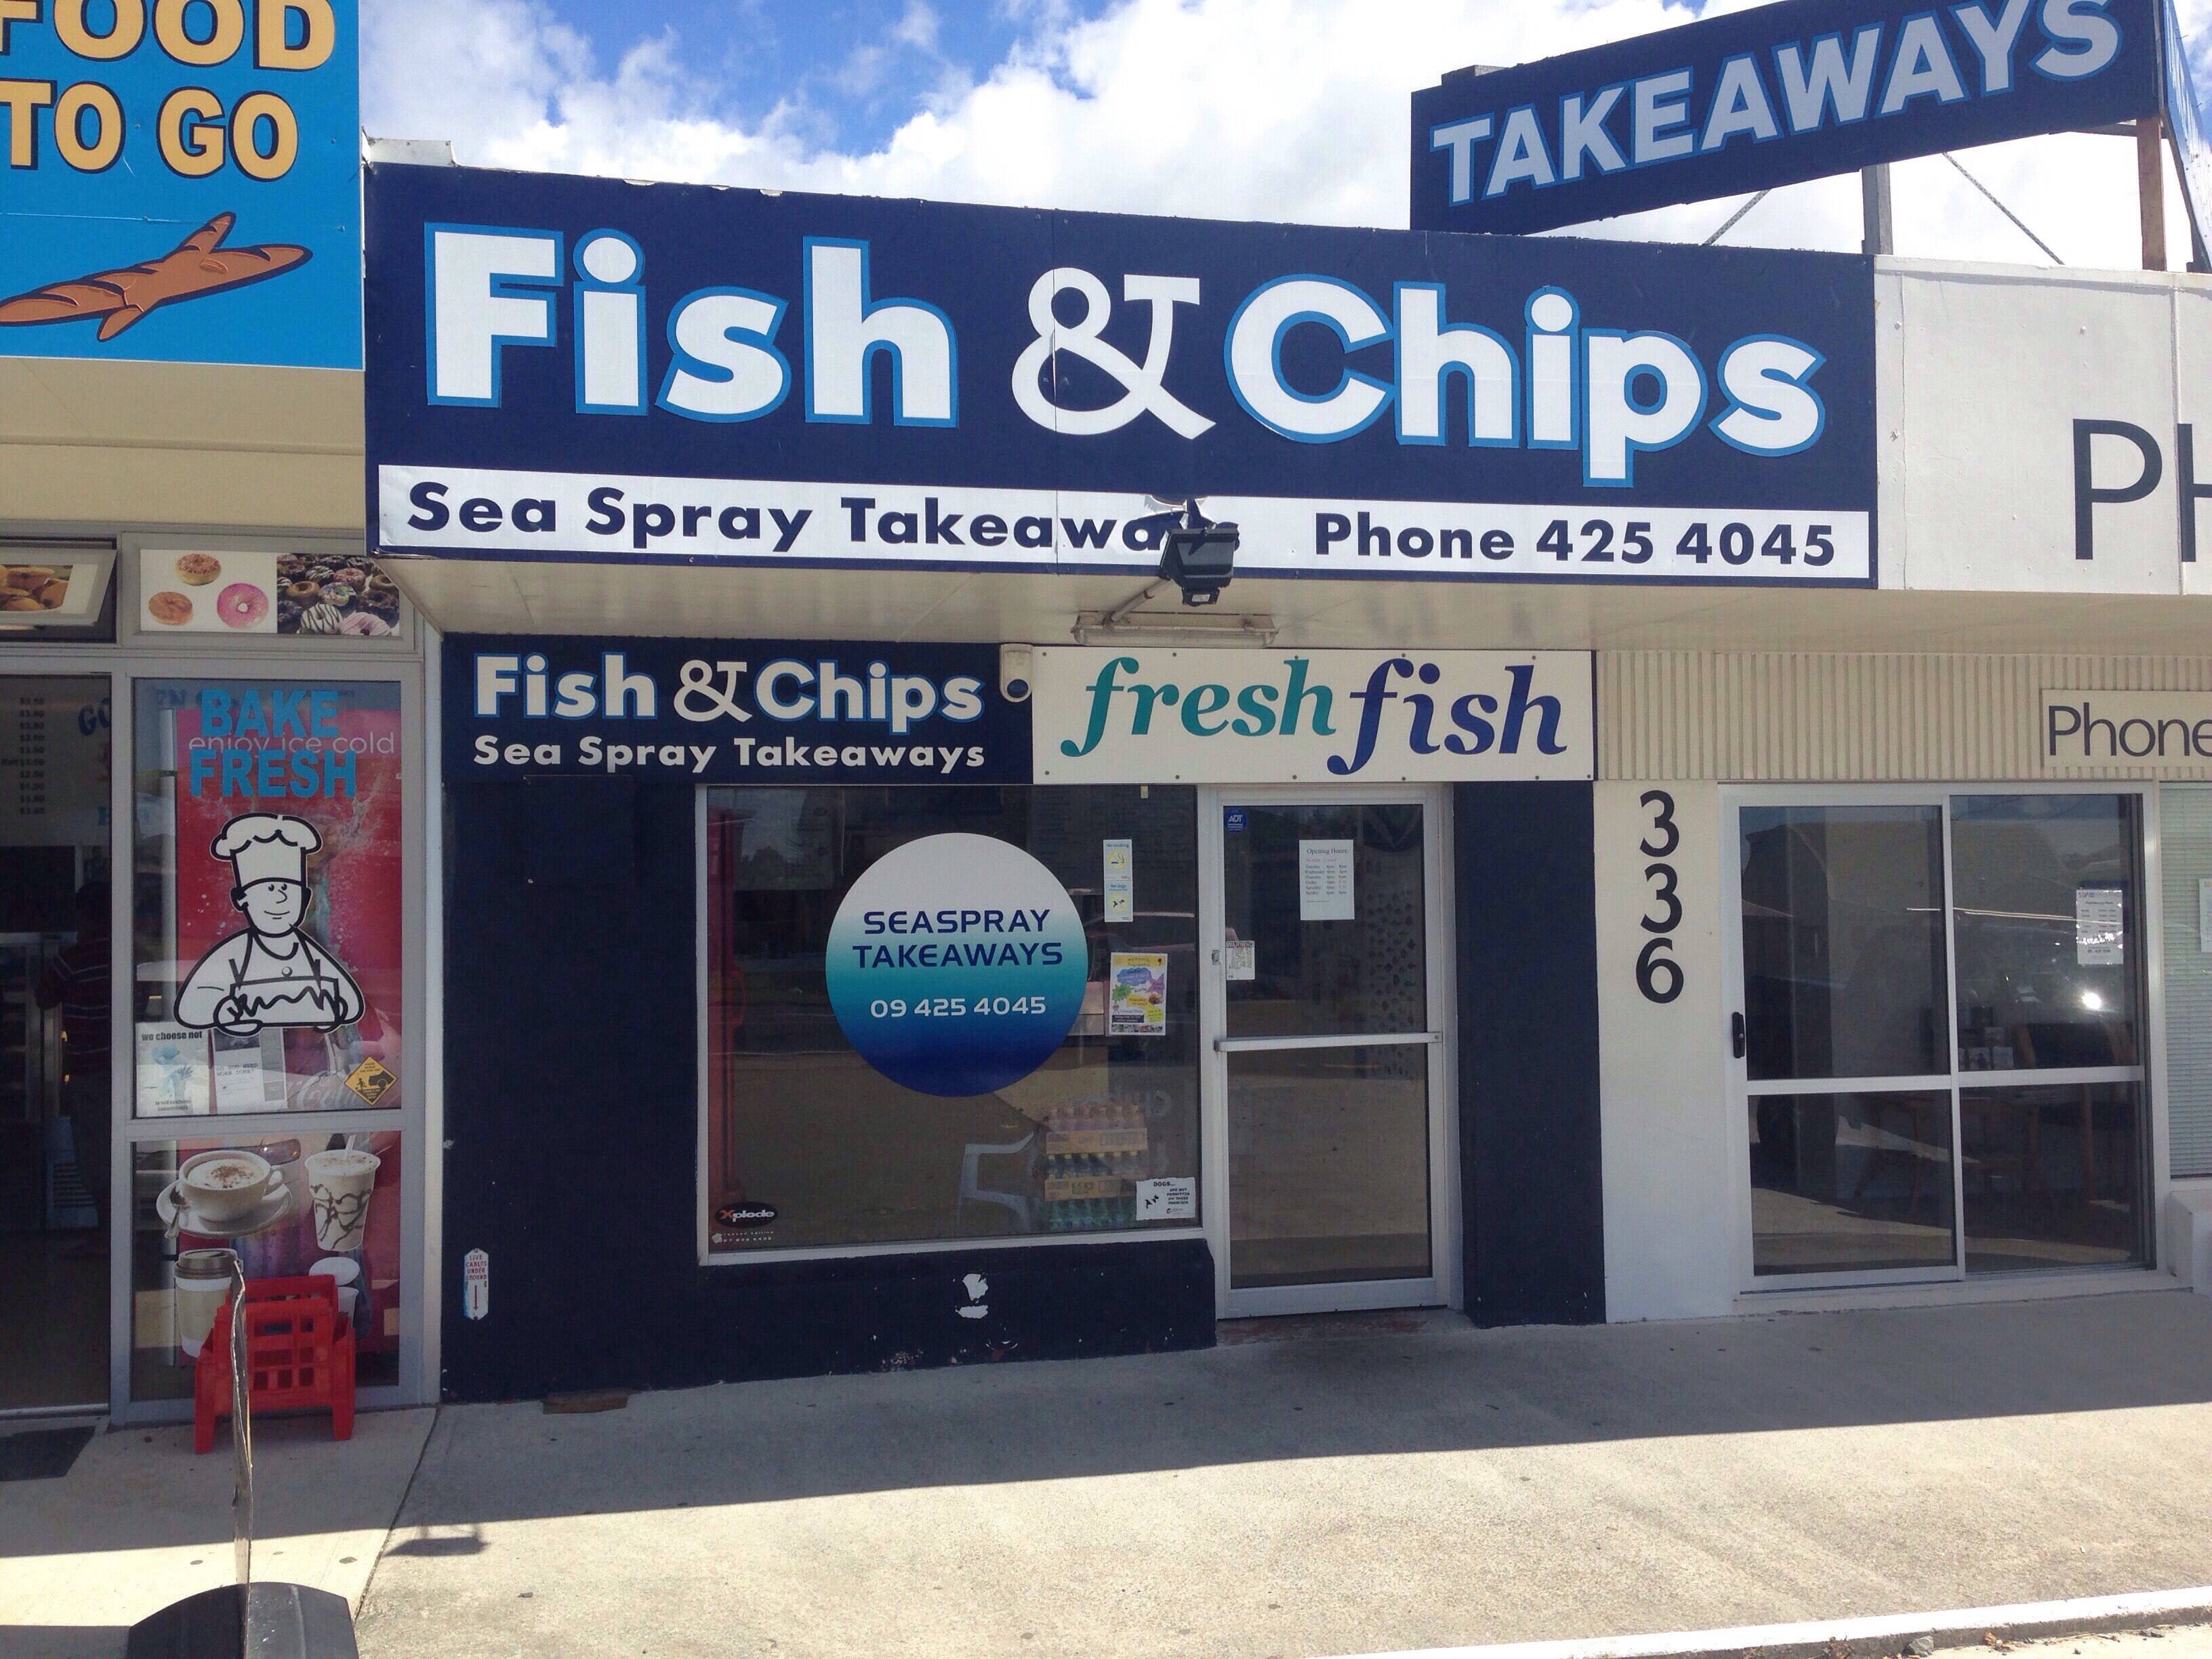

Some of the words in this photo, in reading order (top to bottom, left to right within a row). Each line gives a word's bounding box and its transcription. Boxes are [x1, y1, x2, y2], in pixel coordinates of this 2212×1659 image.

[1430, 0, 2121, 205] TAKEAWAYS
[0, 79, 125, 173] TO
[156, 87, 298, 182] GO
[428, 225, 956, 424] Fish
[1012, 268, 1216, 439] &
[1227, 275, 1824, 485] Chips
[408, 482, 556, 533] Sea
[586, 487, 813, 552] Spray
[842, 497, 1240, 553] Takeawa
[1315, 511, 1515, 560] Phone
[1536, 519, 1654, 563] 425
[1676, 523, 1835, 567] 4045
[201, 689, 340, 737] BAKE
[474, 653, 657, 720] Fish
[674, 660, 752, 722] &
[754, 658, 985, 735] Chips
[1061, 657, 1335, 757] fresh
[1327, 658, 1568, 775] fish
[282, 733, 321, 753] ice
[333, 732, 394, 754] cold
[474, 735, 561, 765] Sea
[578, 737, 716, 773] Spray
[734, 737, 985, 773] Takeaways
[2049, 702, 2212, 757] Phone
[190, 747, 356, 798] FRESH
[864, 909, 1050, 934] SEASPRAY
[853, 943, 1063, 968] TAKEAWAYS
[870, 999, 907, 1018] 09
[914, 998, 966, 1017] 425
[973, 996, 1046, 1015] 4045
[156, 1031, 187, 1041] choose
[188, 1031, 203, 1039] not
[720, 1209, 775, 1222] Xplode
